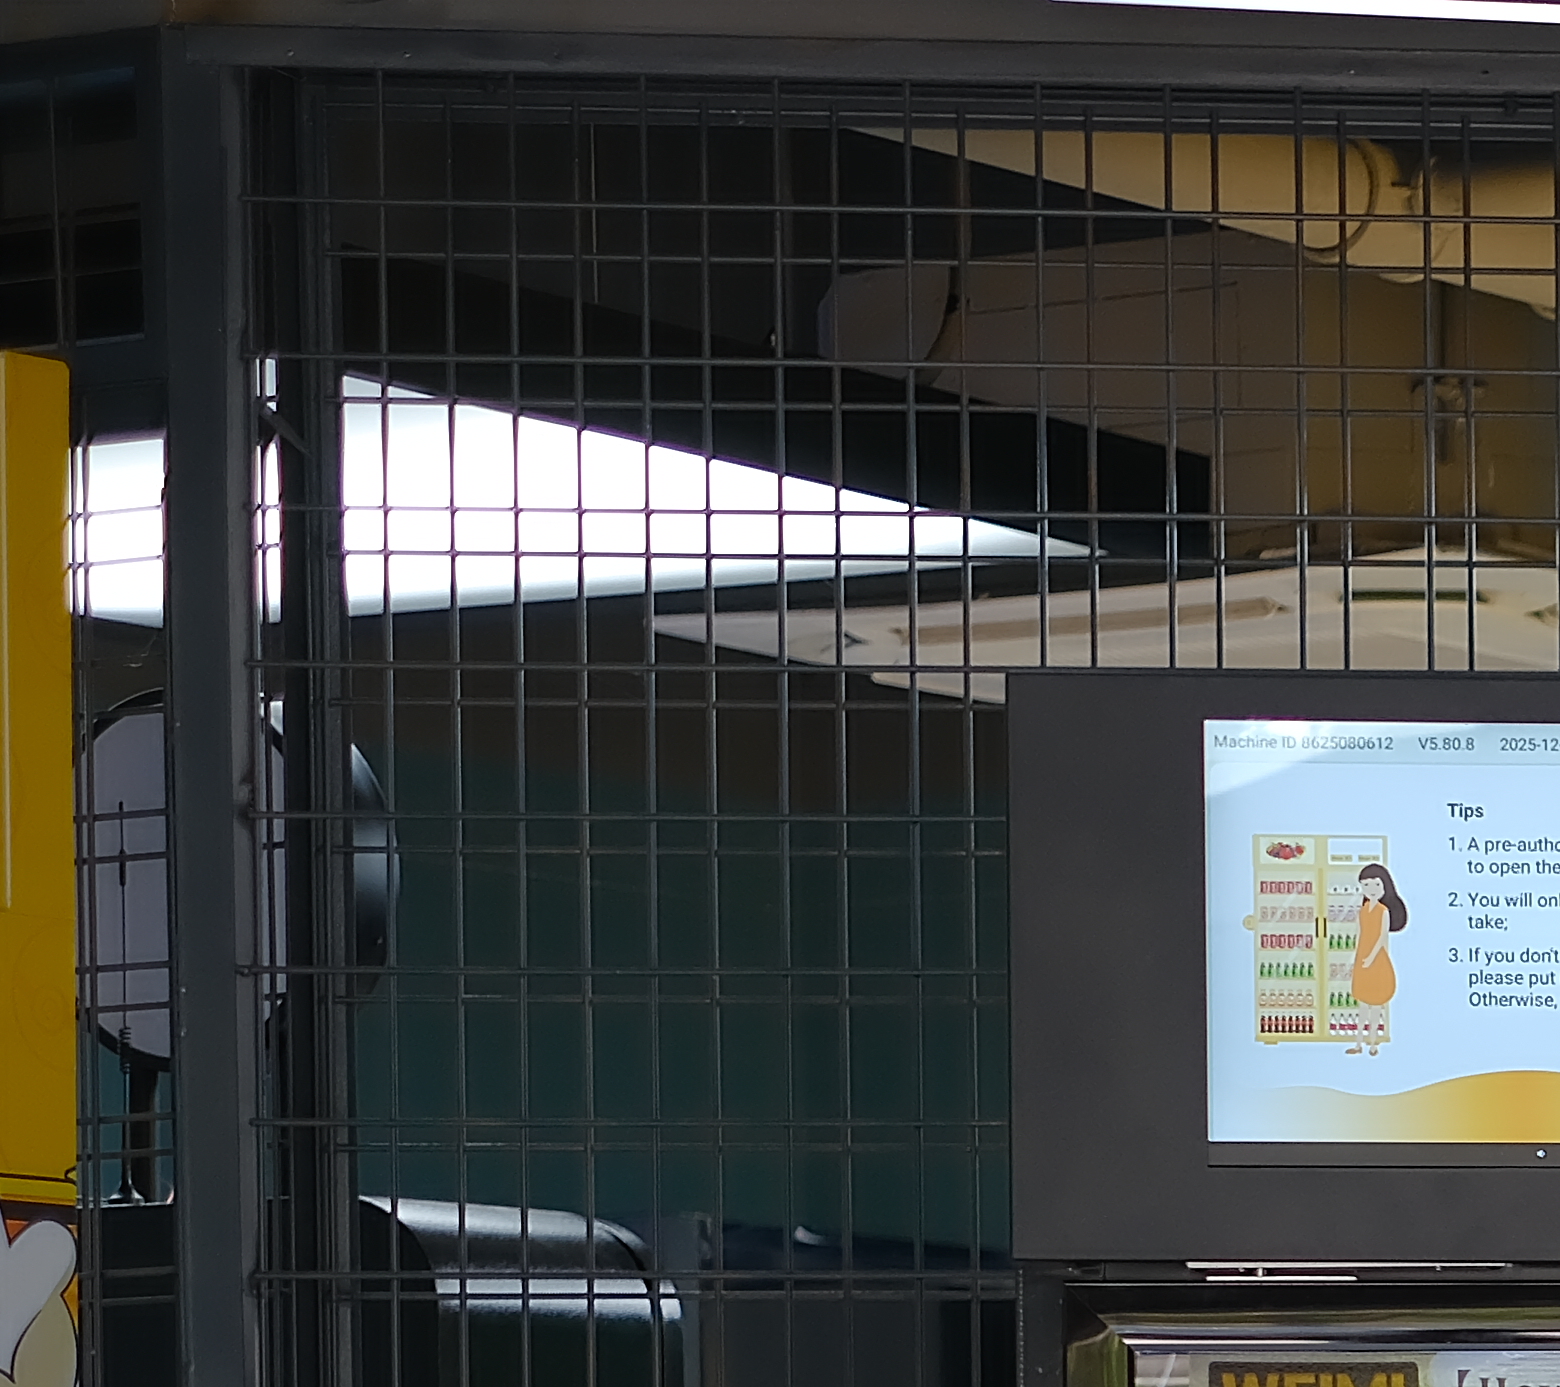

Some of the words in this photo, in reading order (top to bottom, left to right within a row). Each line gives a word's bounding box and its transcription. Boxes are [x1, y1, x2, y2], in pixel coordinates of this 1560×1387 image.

[1214, 734, 1278, 749] Machine
[1282, 736, 1297, 749] ID
[1301, 736, 1394, 751] 8625080612
[1417, 736, 1475, 751] V5.80.8
[1446, 802, 1484, 822] Tips
[1448, 836, 1463, 852] 1.
[1467, 836, 1480, 852] A
